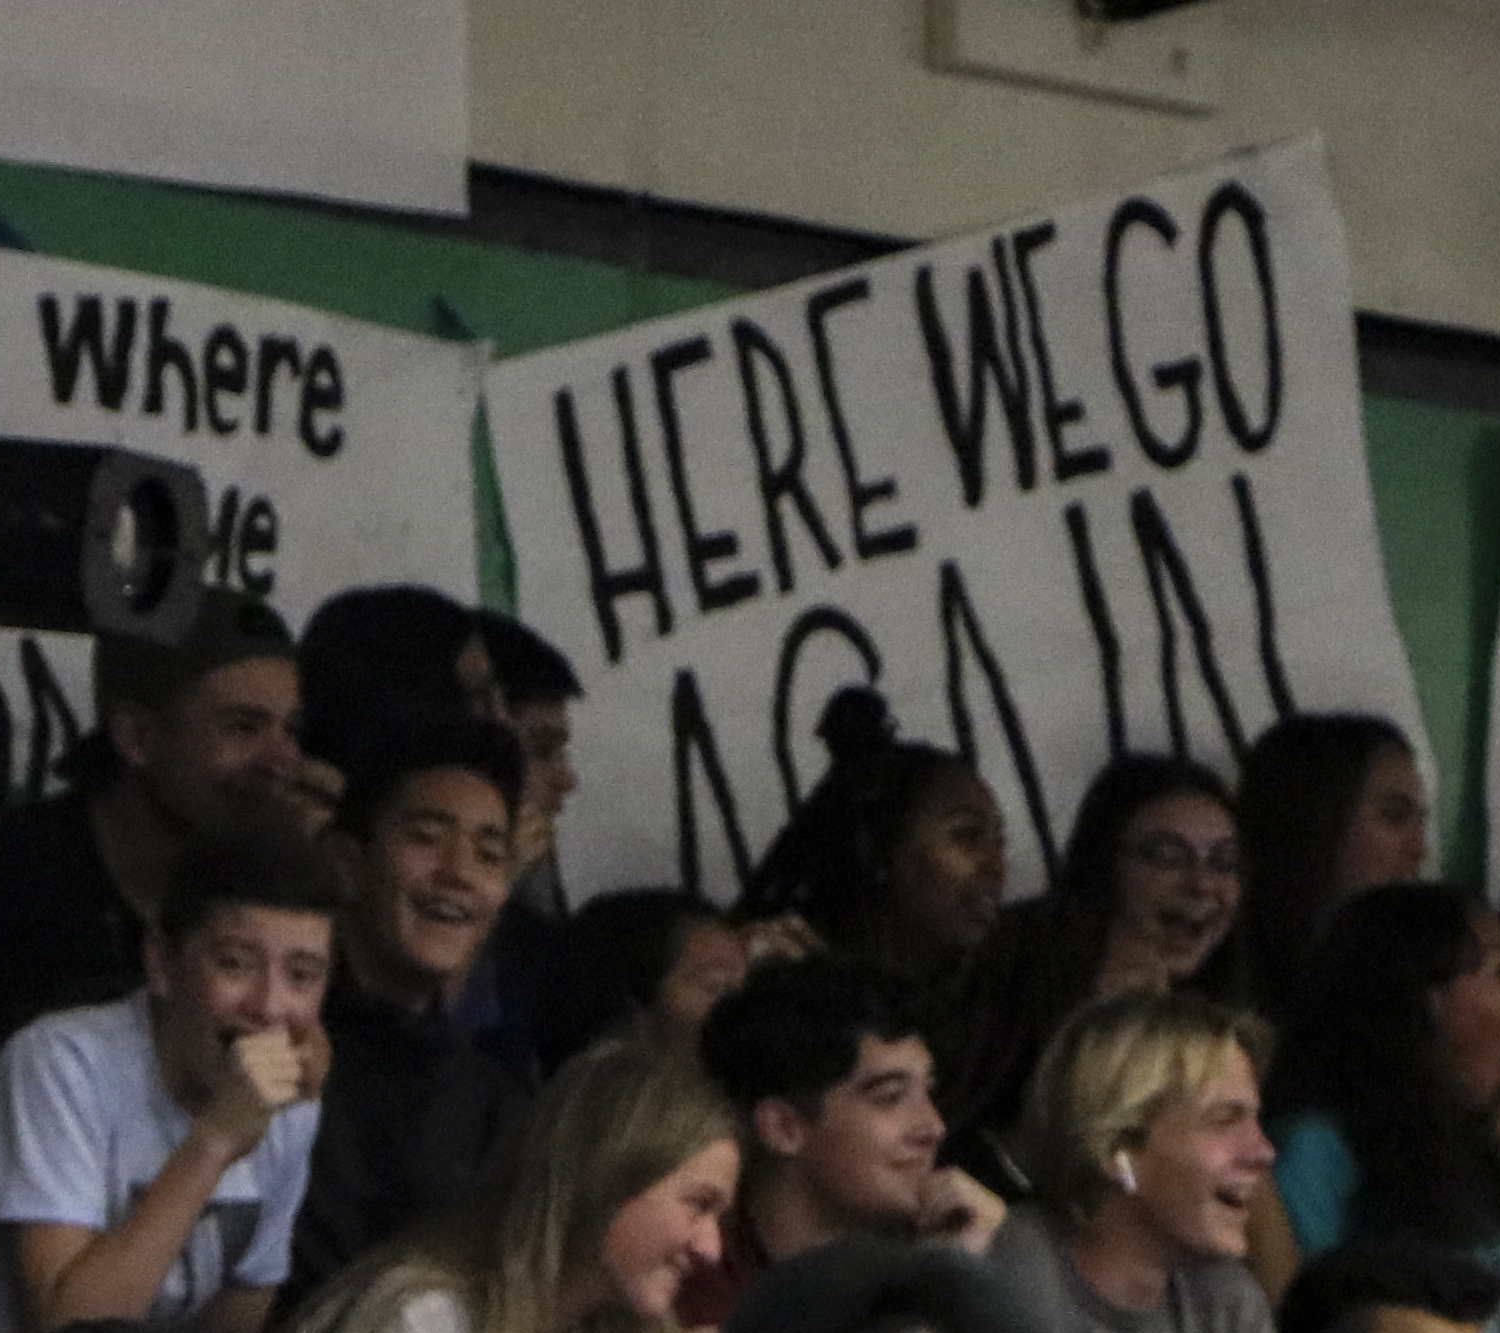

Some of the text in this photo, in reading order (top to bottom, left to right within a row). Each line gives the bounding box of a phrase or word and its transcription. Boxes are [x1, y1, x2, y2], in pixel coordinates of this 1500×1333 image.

[38, 291, 347, 458] Where
[555, 181, 1282, 662] HERE WE GO
